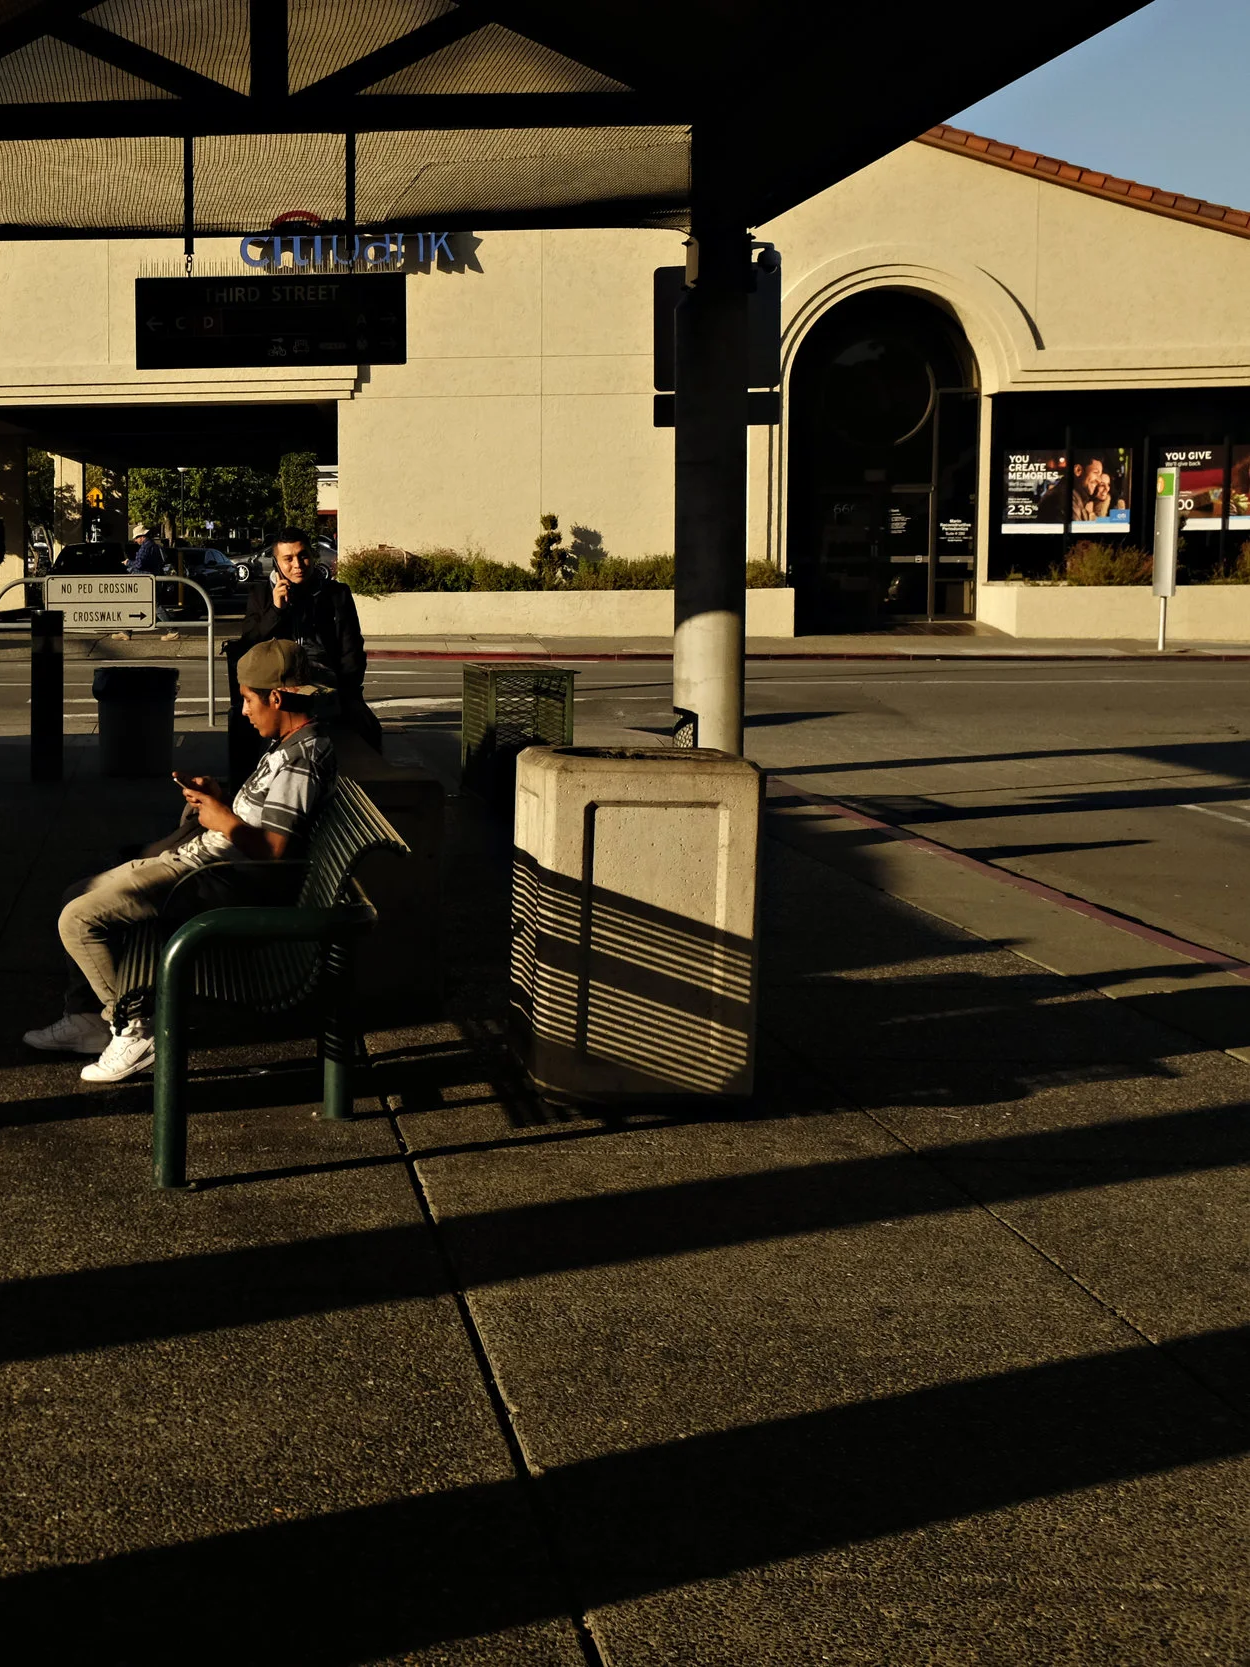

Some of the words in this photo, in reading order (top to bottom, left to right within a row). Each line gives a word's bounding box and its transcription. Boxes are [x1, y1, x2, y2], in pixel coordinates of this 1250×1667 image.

[205, 287, 260, 303] THIRD
[272, 285, 340, 302] STREET
[175, 316, 187, 330] C
[203, 316, 214, 329] D
[1008, 455, 1030, 463] YOU
[1165, 452, 1186, 461] YOU
[1188, 451, 1212, 460] GIVE
[1008, 463, 1047, 471] CREATE
[1008, 471, 1059, 480] MEMORIES
[1007, 504, 1039, 516] 2.35%
[61, 583, 72, 594] NO
[78, 583, 93, 594] PED
[98, 583, 139, 594] CROSSING
[73, 611, 122, 622] CROSSWALK
